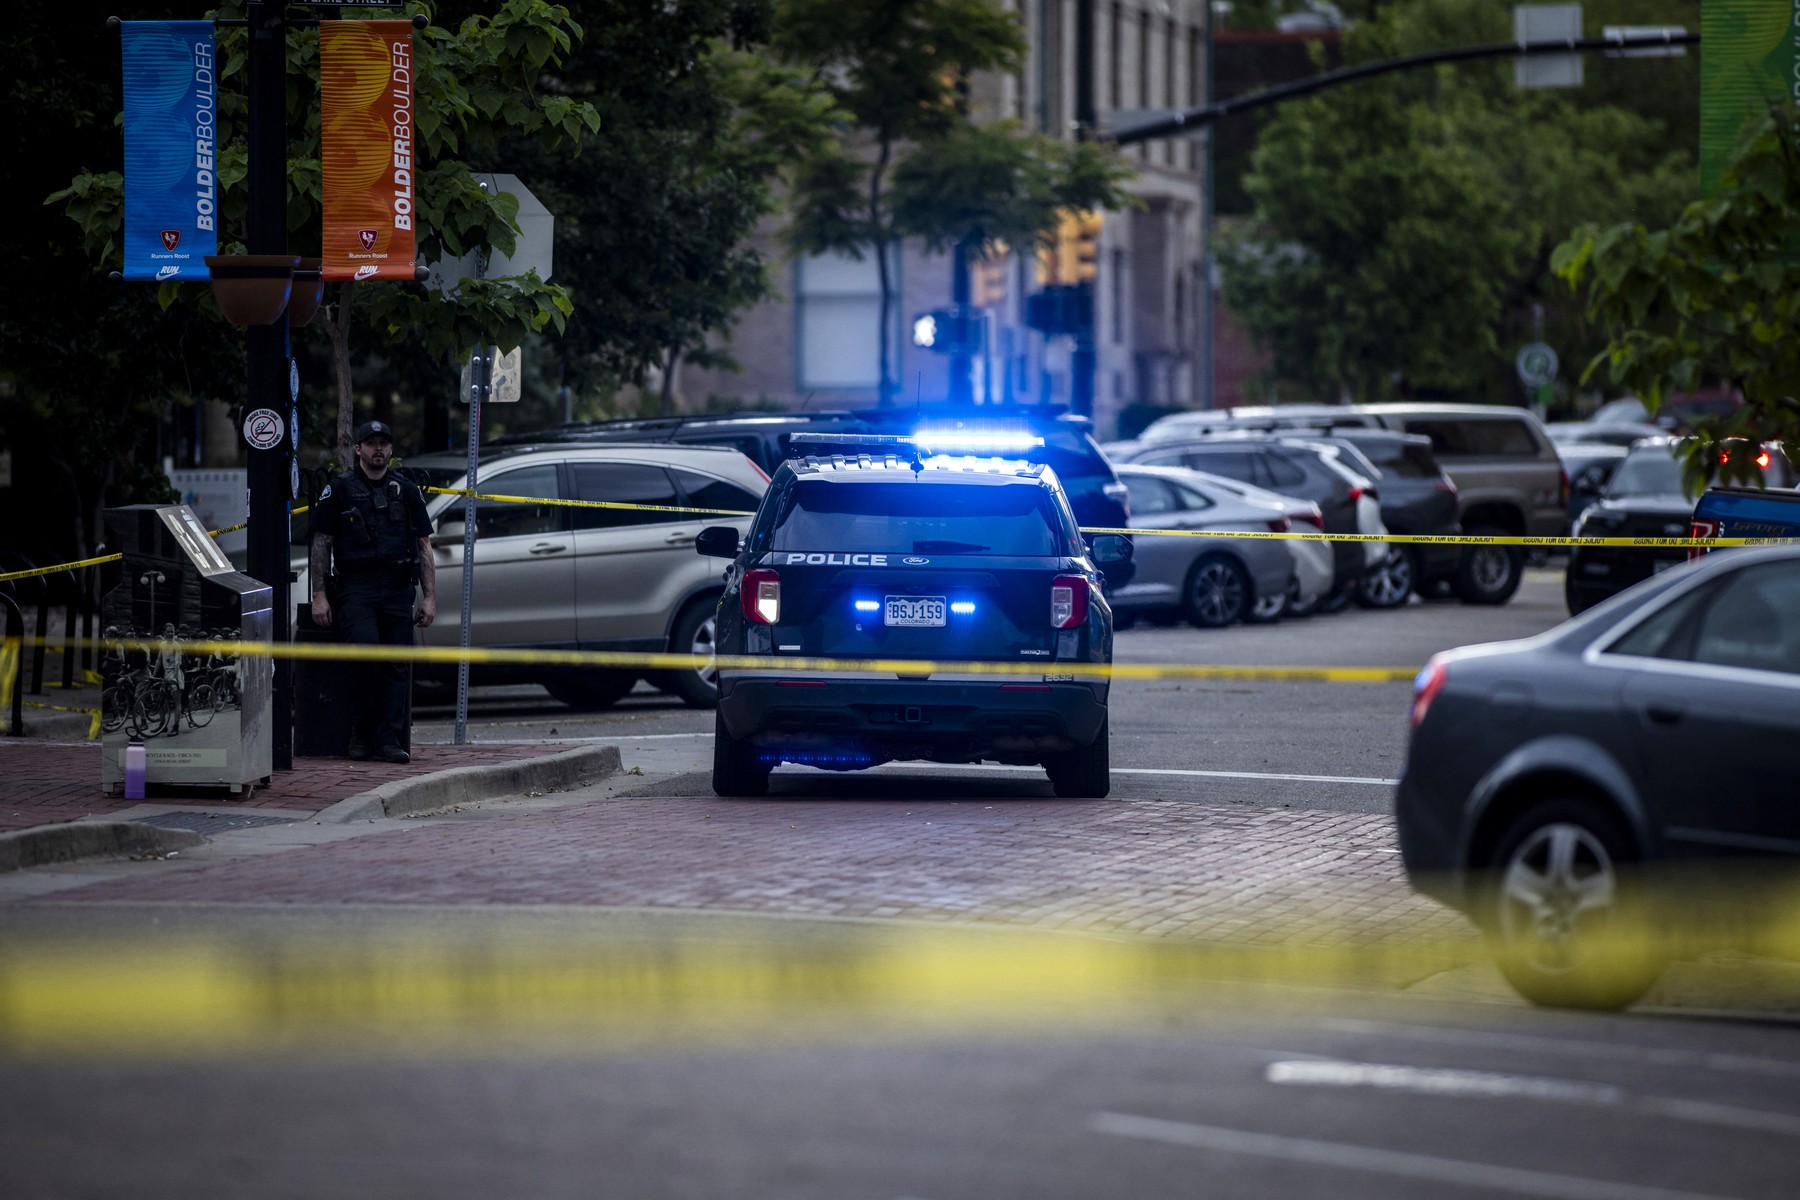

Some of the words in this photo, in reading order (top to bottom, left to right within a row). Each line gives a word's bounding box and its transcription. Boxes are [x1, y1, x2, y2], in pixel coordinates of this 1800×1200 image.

[160, 266, 180, 274] RUN
[359, 265, 378, 273] RUN
[247, 411, 259, 423] SMOKE
[269, 412, 280, 421] ZONE
[786, 554, 888, 566] POLICE
[1046, 673, 1072, 682] 2632
